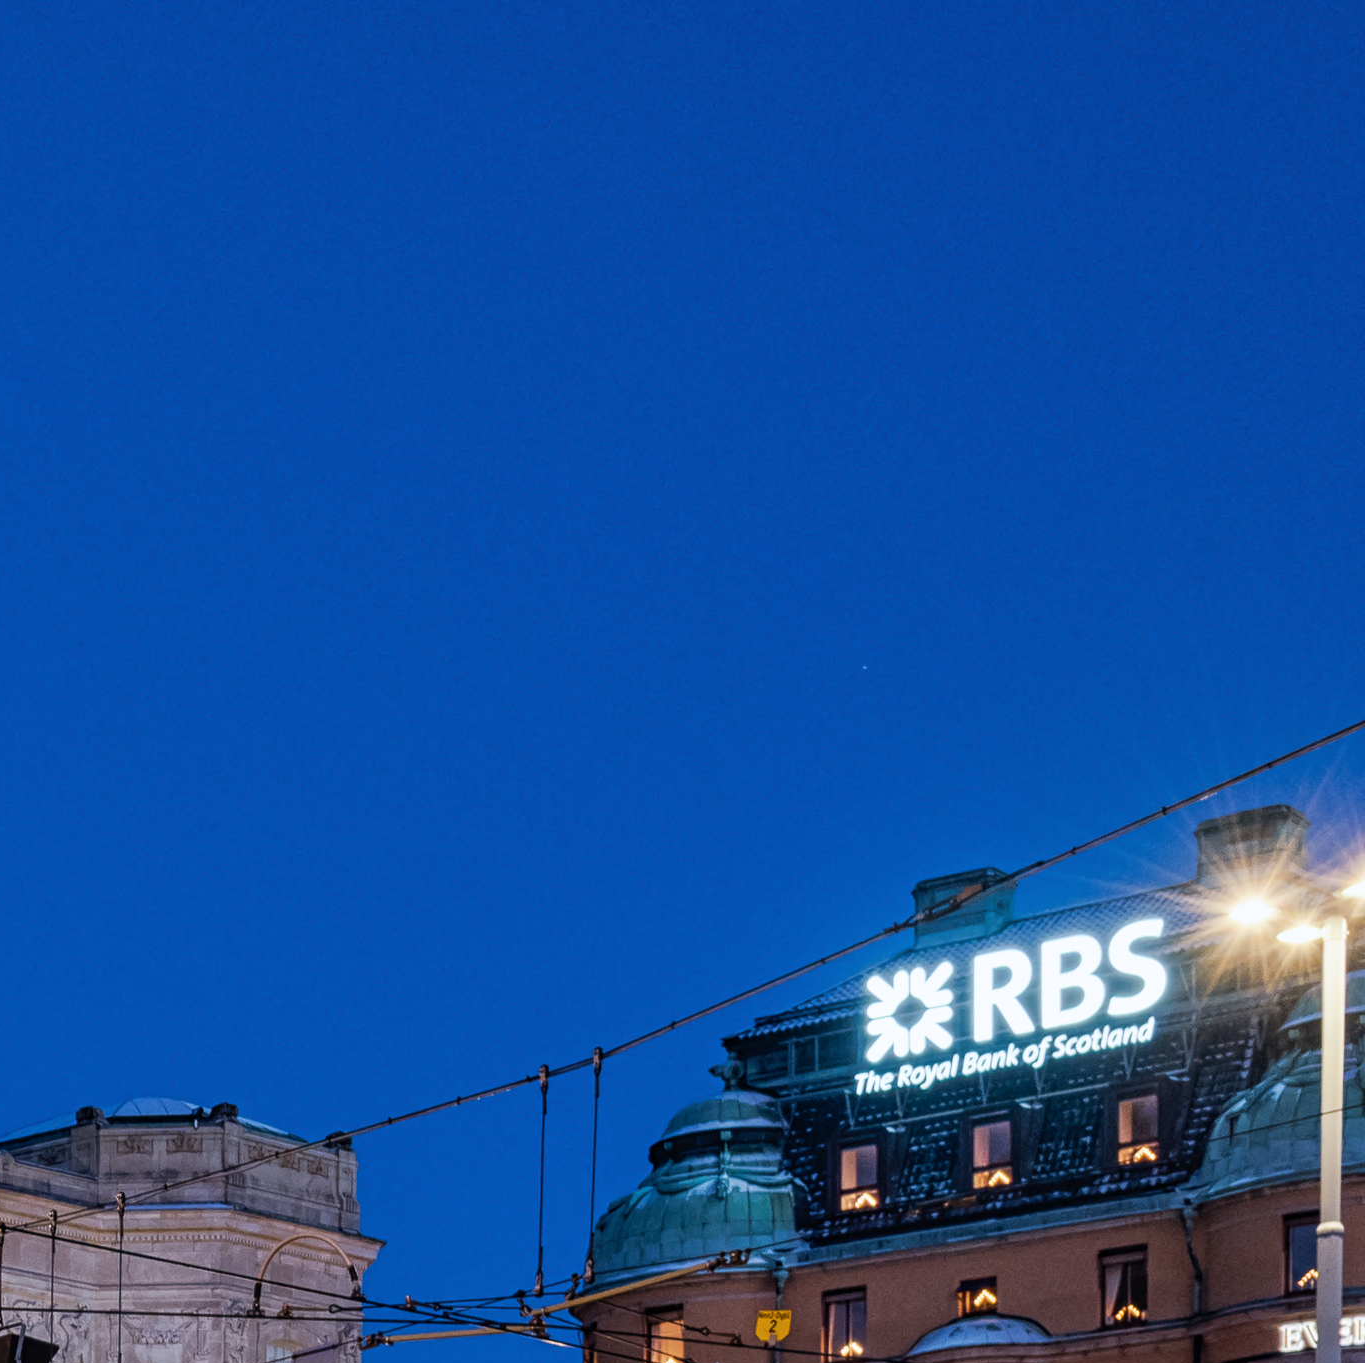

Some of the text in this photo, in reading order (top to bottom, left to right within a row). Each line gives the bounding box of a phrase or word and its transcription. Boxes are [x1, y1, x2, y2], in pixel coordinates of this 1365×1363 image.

[974, 918, 1167, 1043] RBS
[854, 1016, 1156, 1095] The Royal Bank of Scotland
[768, 1319, 778, 1333] 2
